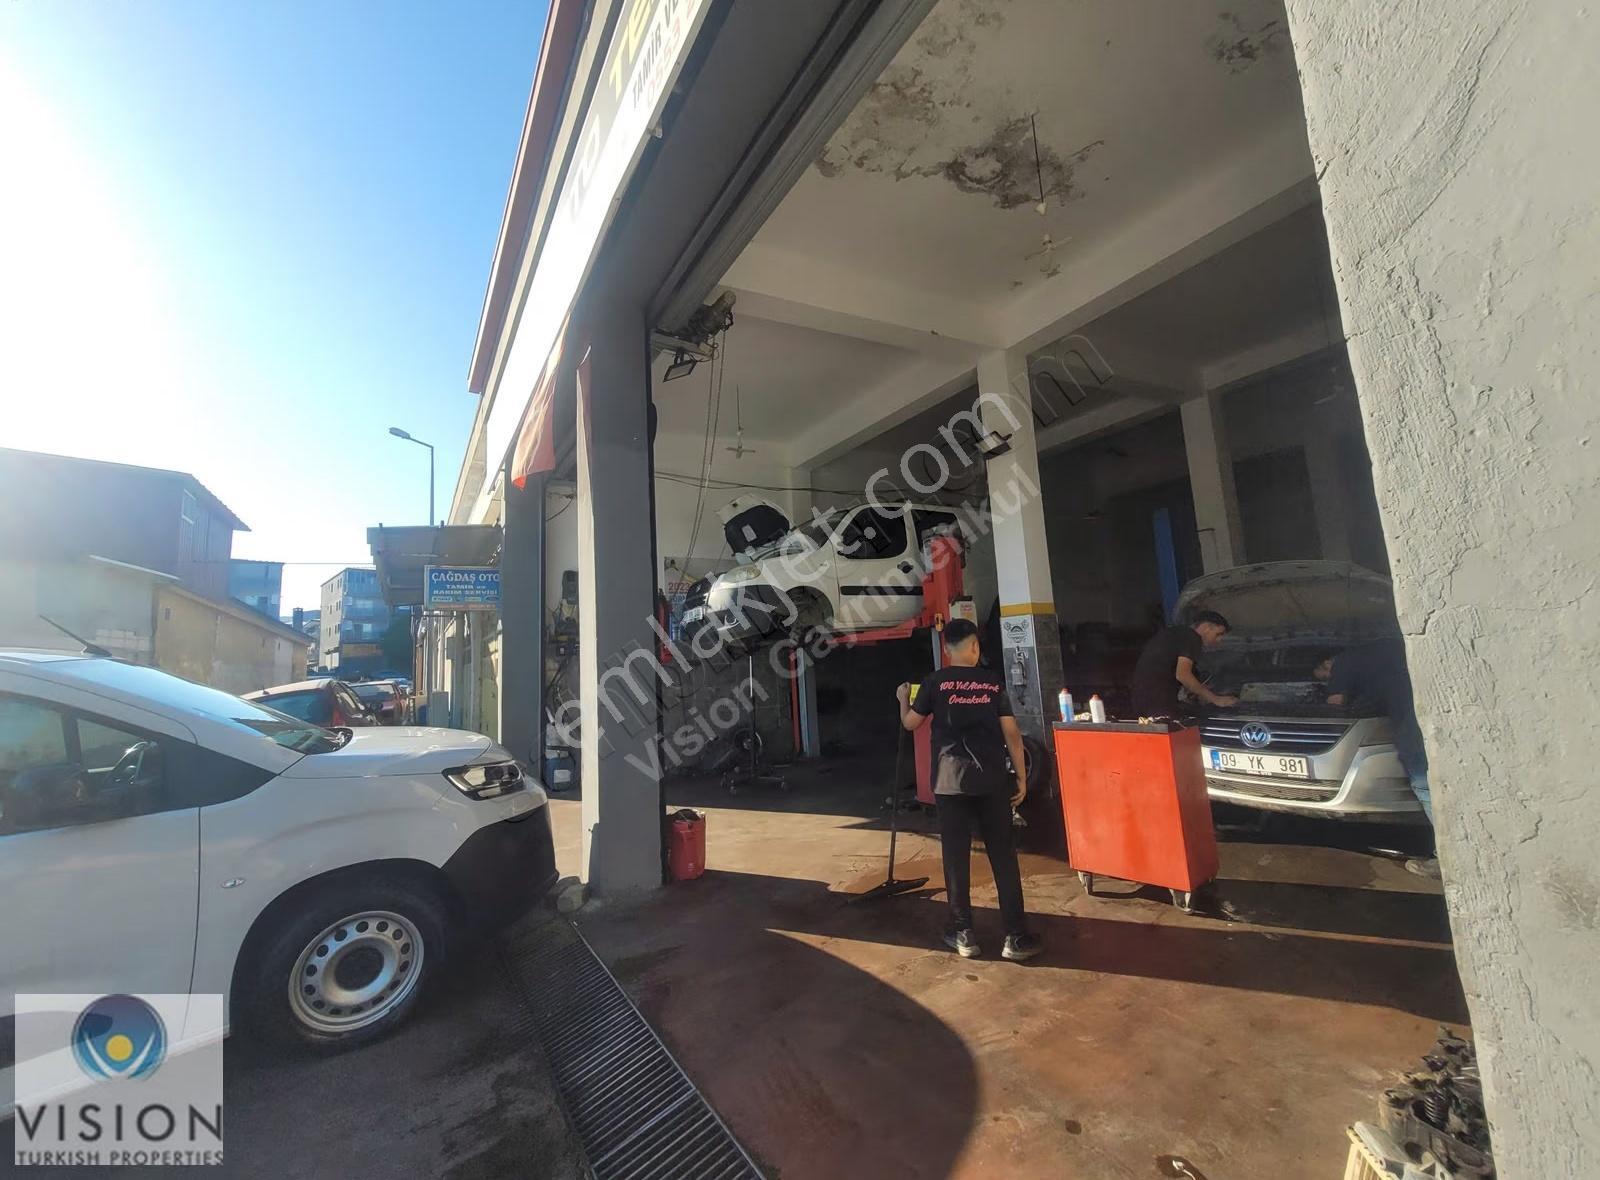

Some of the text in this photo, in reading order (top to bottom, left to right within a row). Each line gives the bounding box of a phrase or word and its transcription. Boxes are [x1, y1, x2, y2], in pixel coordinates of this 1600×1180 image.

[431, 570, 476, 584] ÇAĞDAŞ
[1221, 753, 1237, 767] 09
[1247, 755, 1265, 770] YK
[1279, 758, 1304, 774] 981
